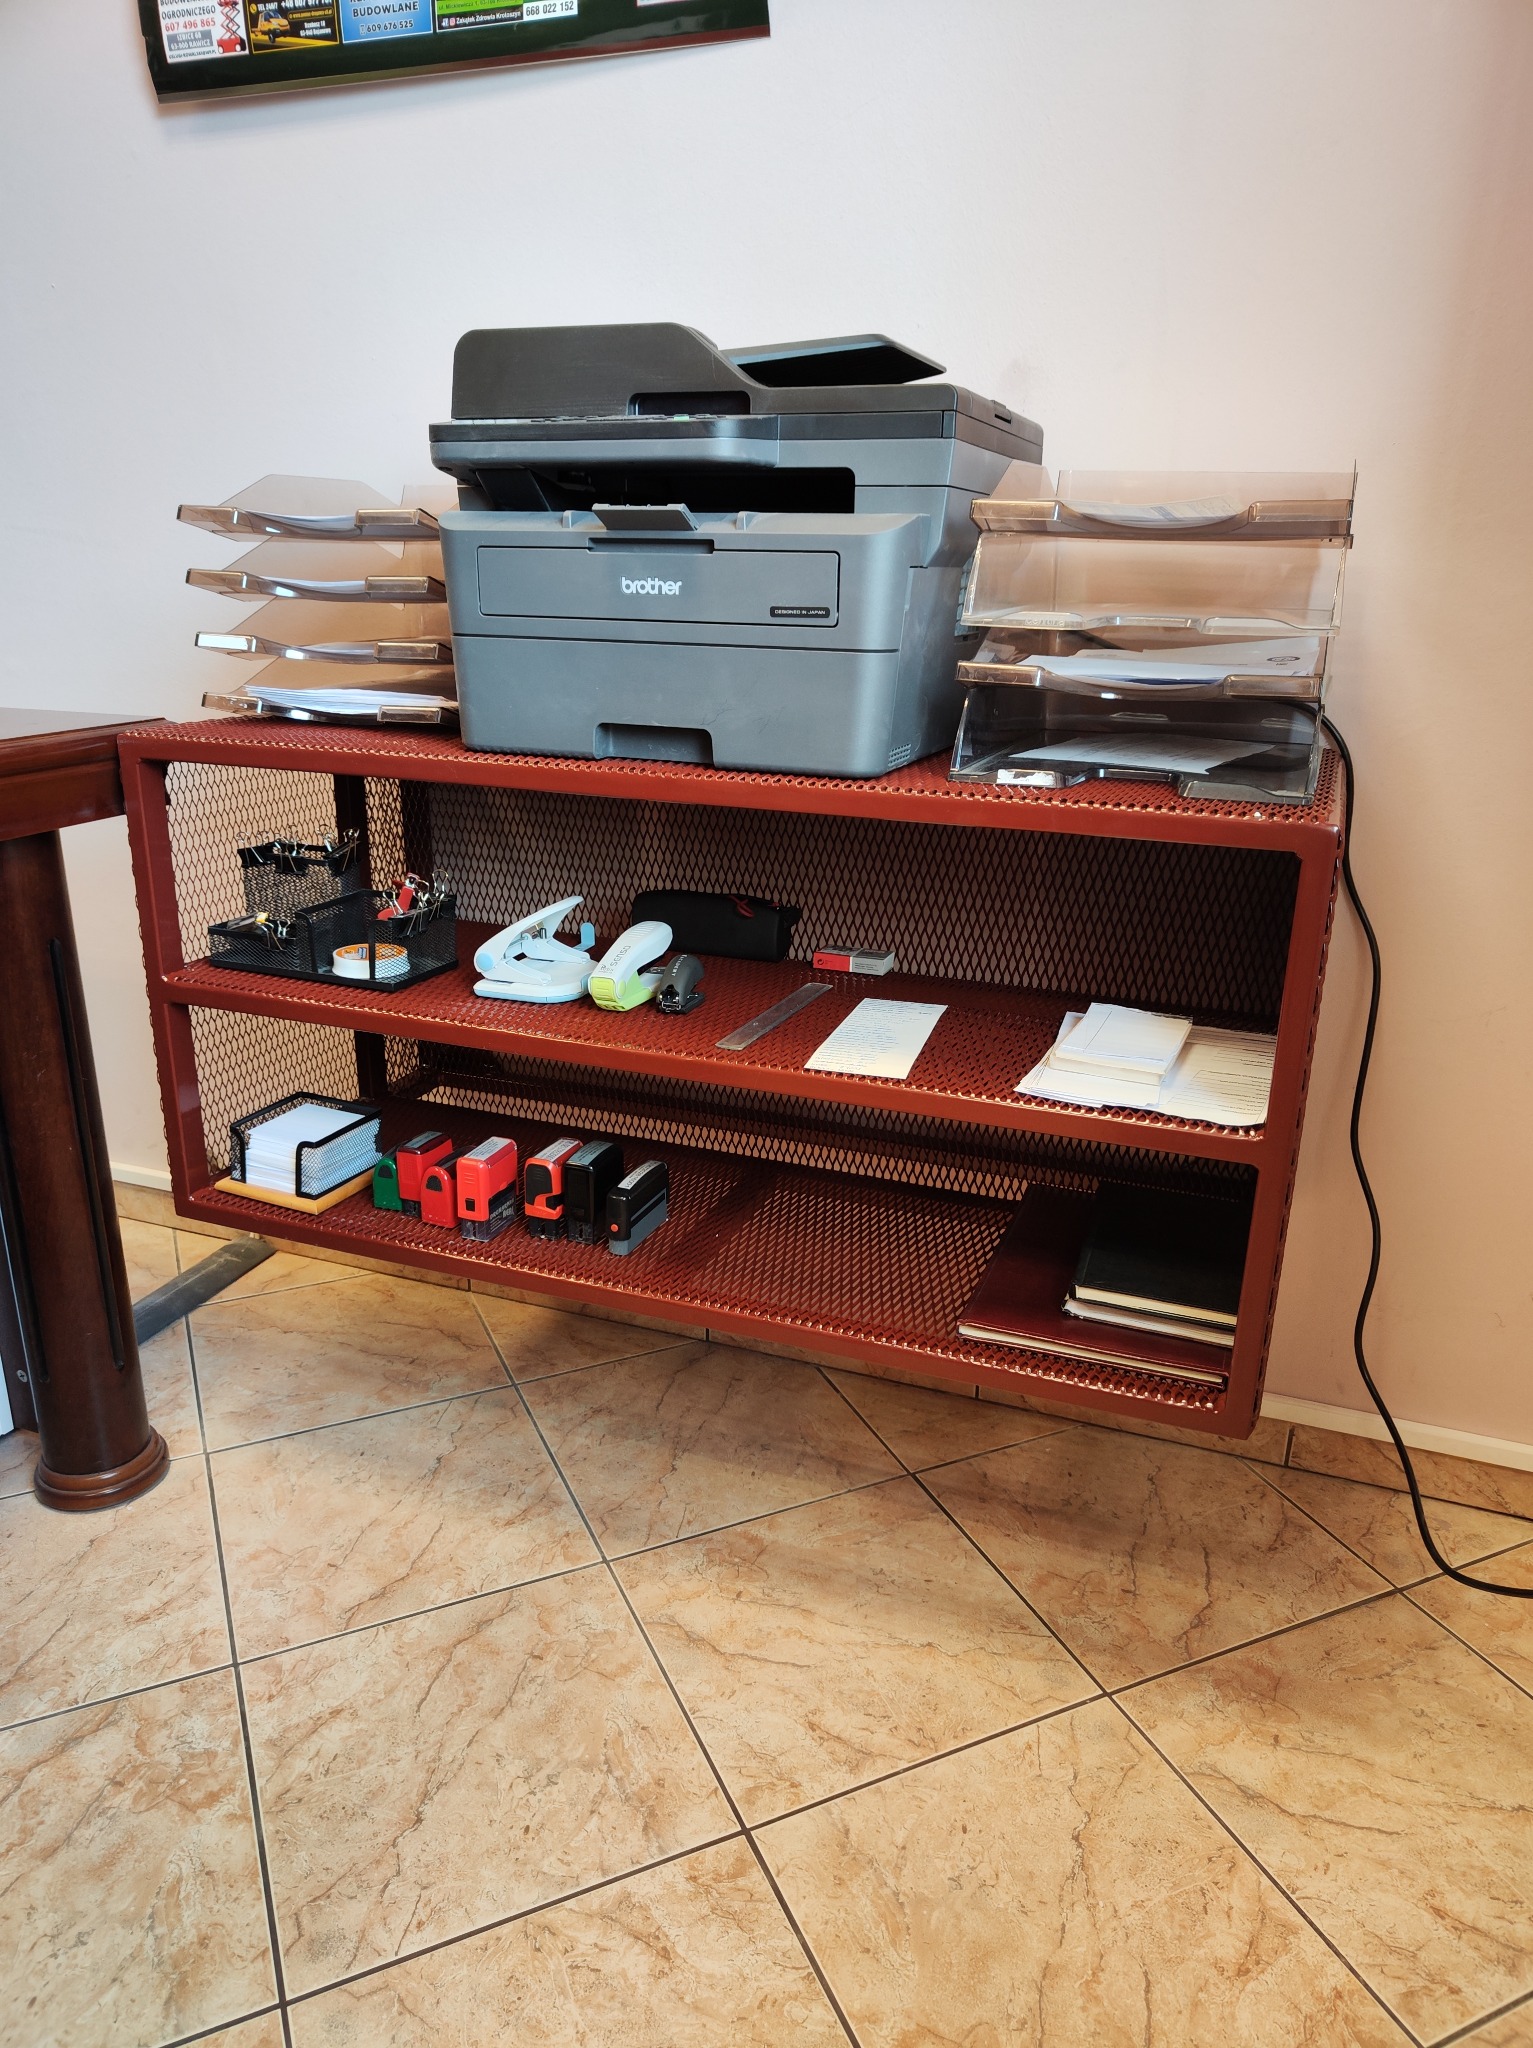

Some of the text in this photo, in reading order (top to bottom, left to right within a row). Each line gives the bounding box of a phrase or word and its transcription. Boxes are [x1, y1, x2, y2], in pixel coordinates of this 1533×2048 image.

[161, 5, 215, 20] OGRODNICZEGO
[352, 1, 418, 17] BUDOWLANE
[525, 0, 574, 16] 668 022 152
[165, 17, 216, 32] 607 496 865
[366, 19, 414, 33] 609 676 525
[621, 576, 683, 596] brother
